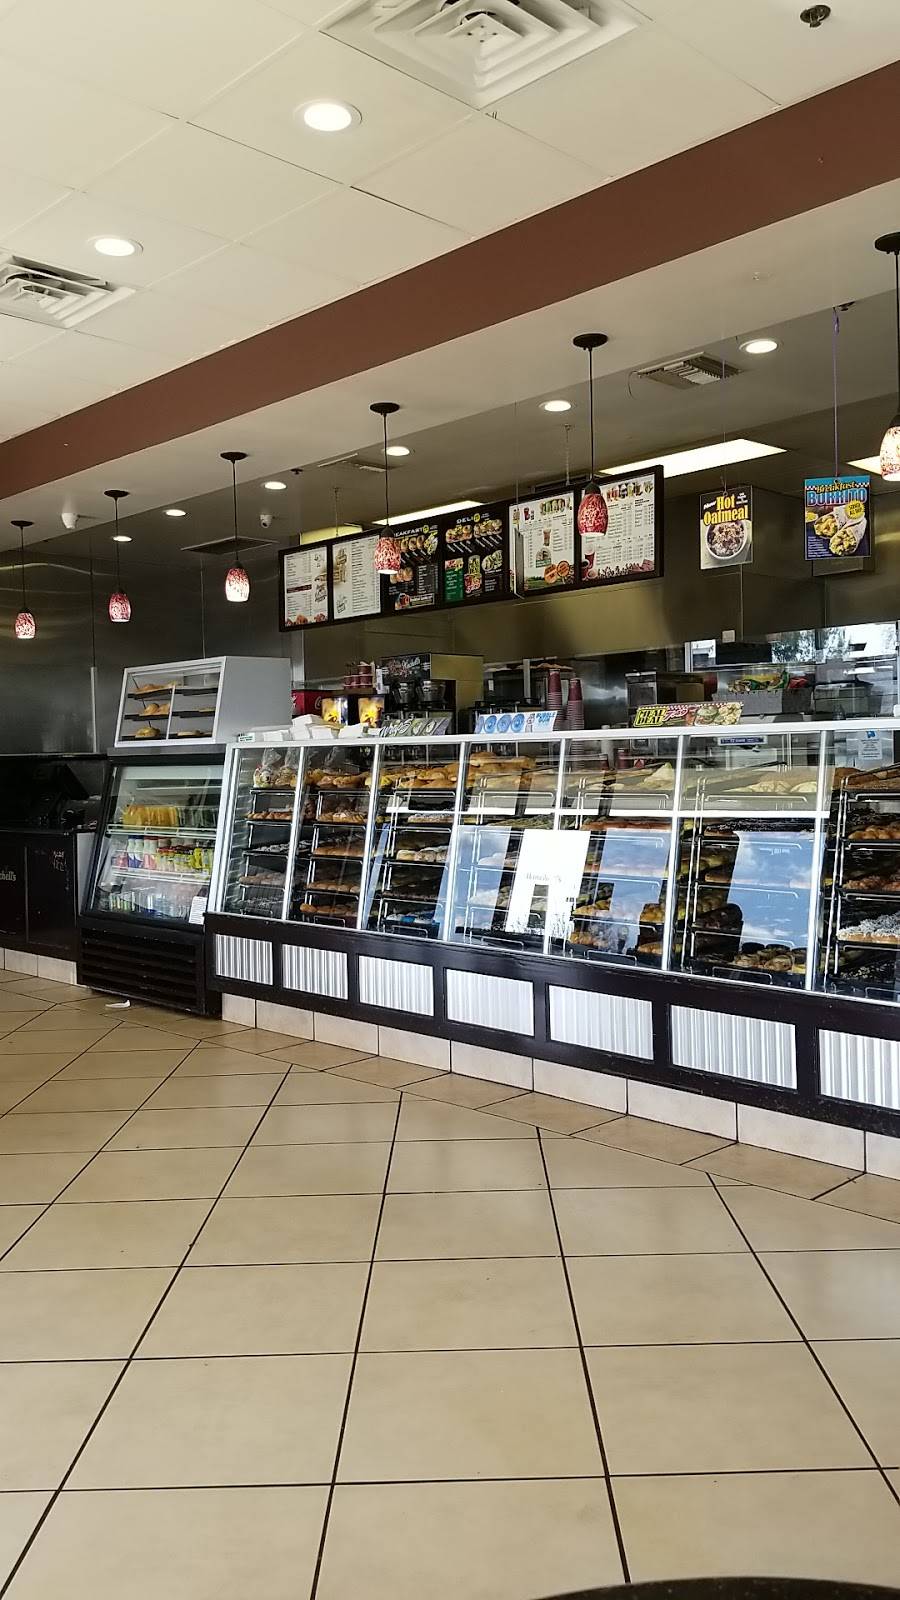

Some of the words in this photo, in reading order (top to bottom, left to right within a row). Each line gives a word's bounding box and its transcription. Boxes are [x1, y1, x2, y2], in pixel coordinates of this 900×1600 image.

[817, 482, 856, 493] Breakfast
[716, 494, 735, 511] Hot
[807, 488, 868, 507] BURRITO
[456, 516, 474, 524] DELI
[703, 505, 749, 526] Oatmeal
